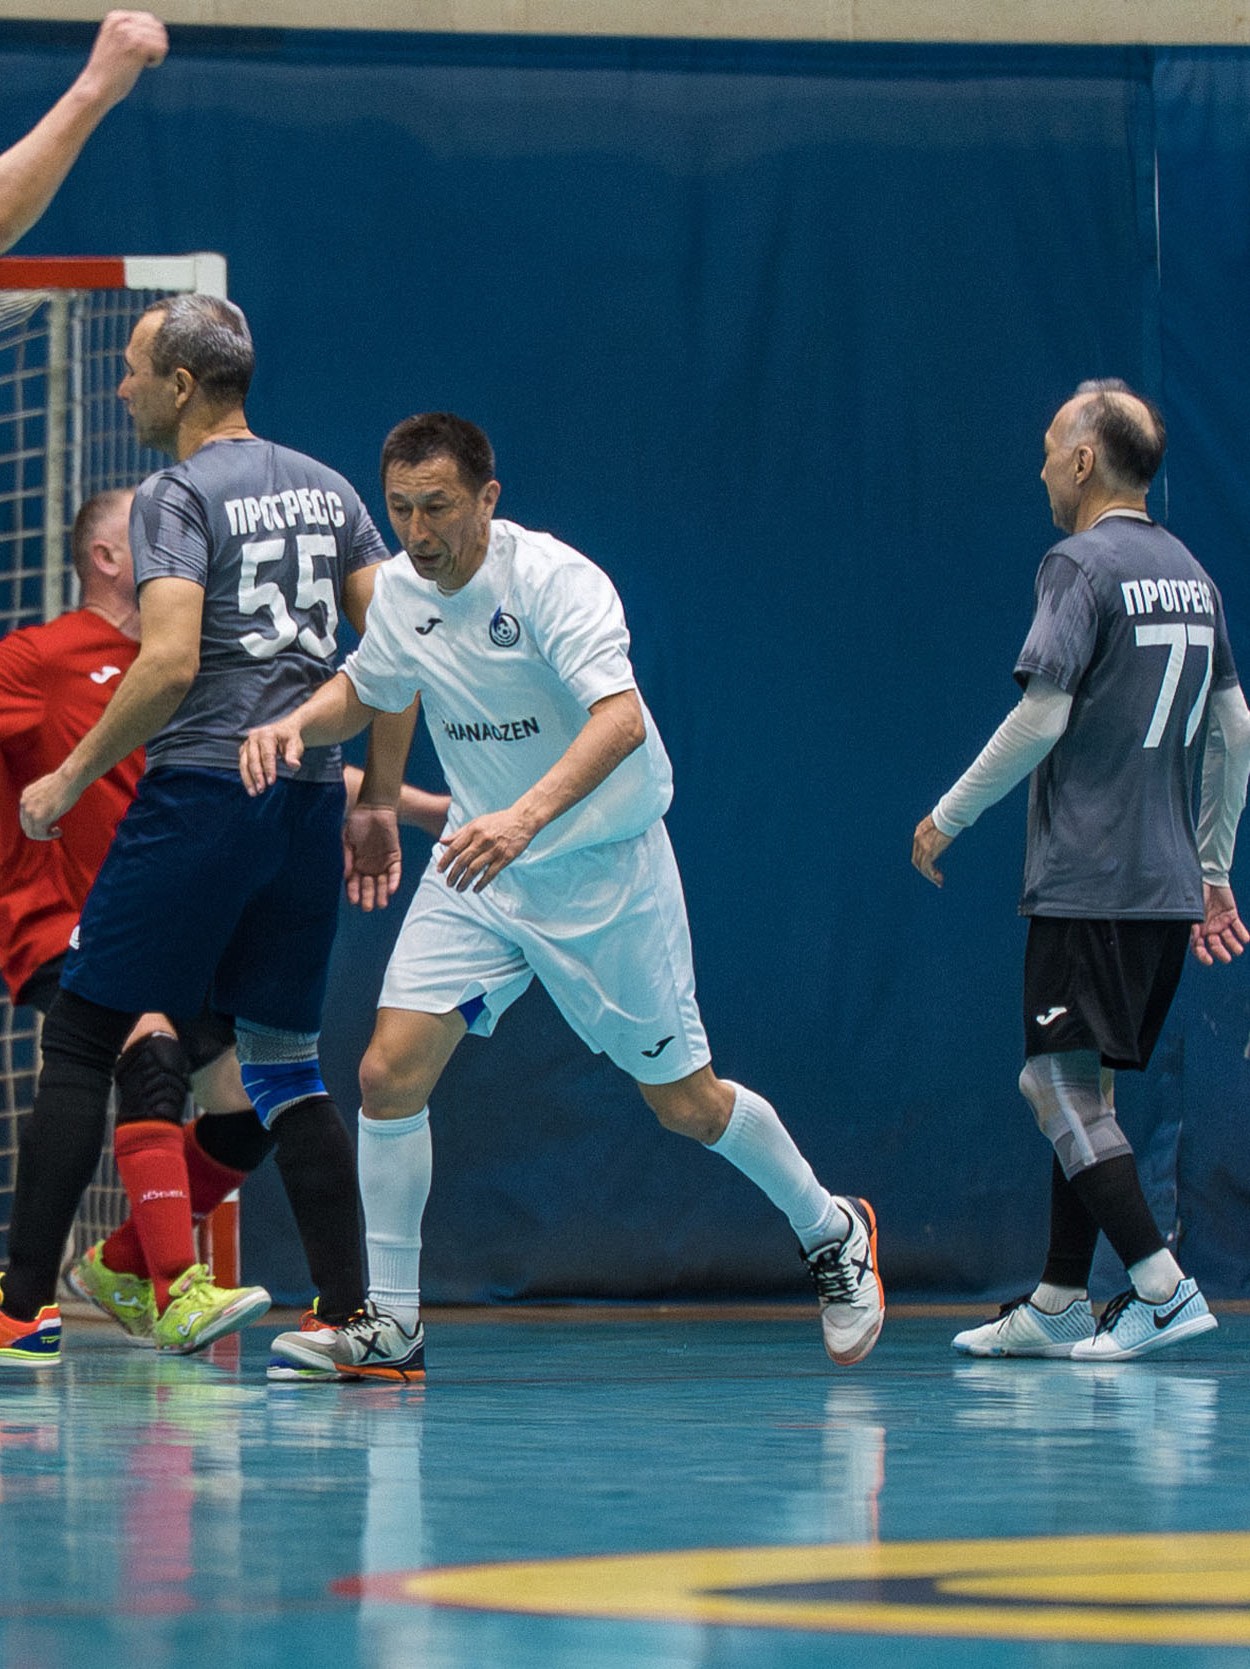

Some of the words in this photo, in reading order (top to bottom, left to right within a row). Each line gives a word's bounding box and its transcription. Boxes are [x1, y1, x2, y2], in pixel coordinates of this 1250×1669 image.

[224, 487, 347, 537] ПРОГРЕСС
[238, 533, 339, 660] 55
[1135, 622, 1215, 748] 77
[442, 717, 541, 742] HANAOZEN
